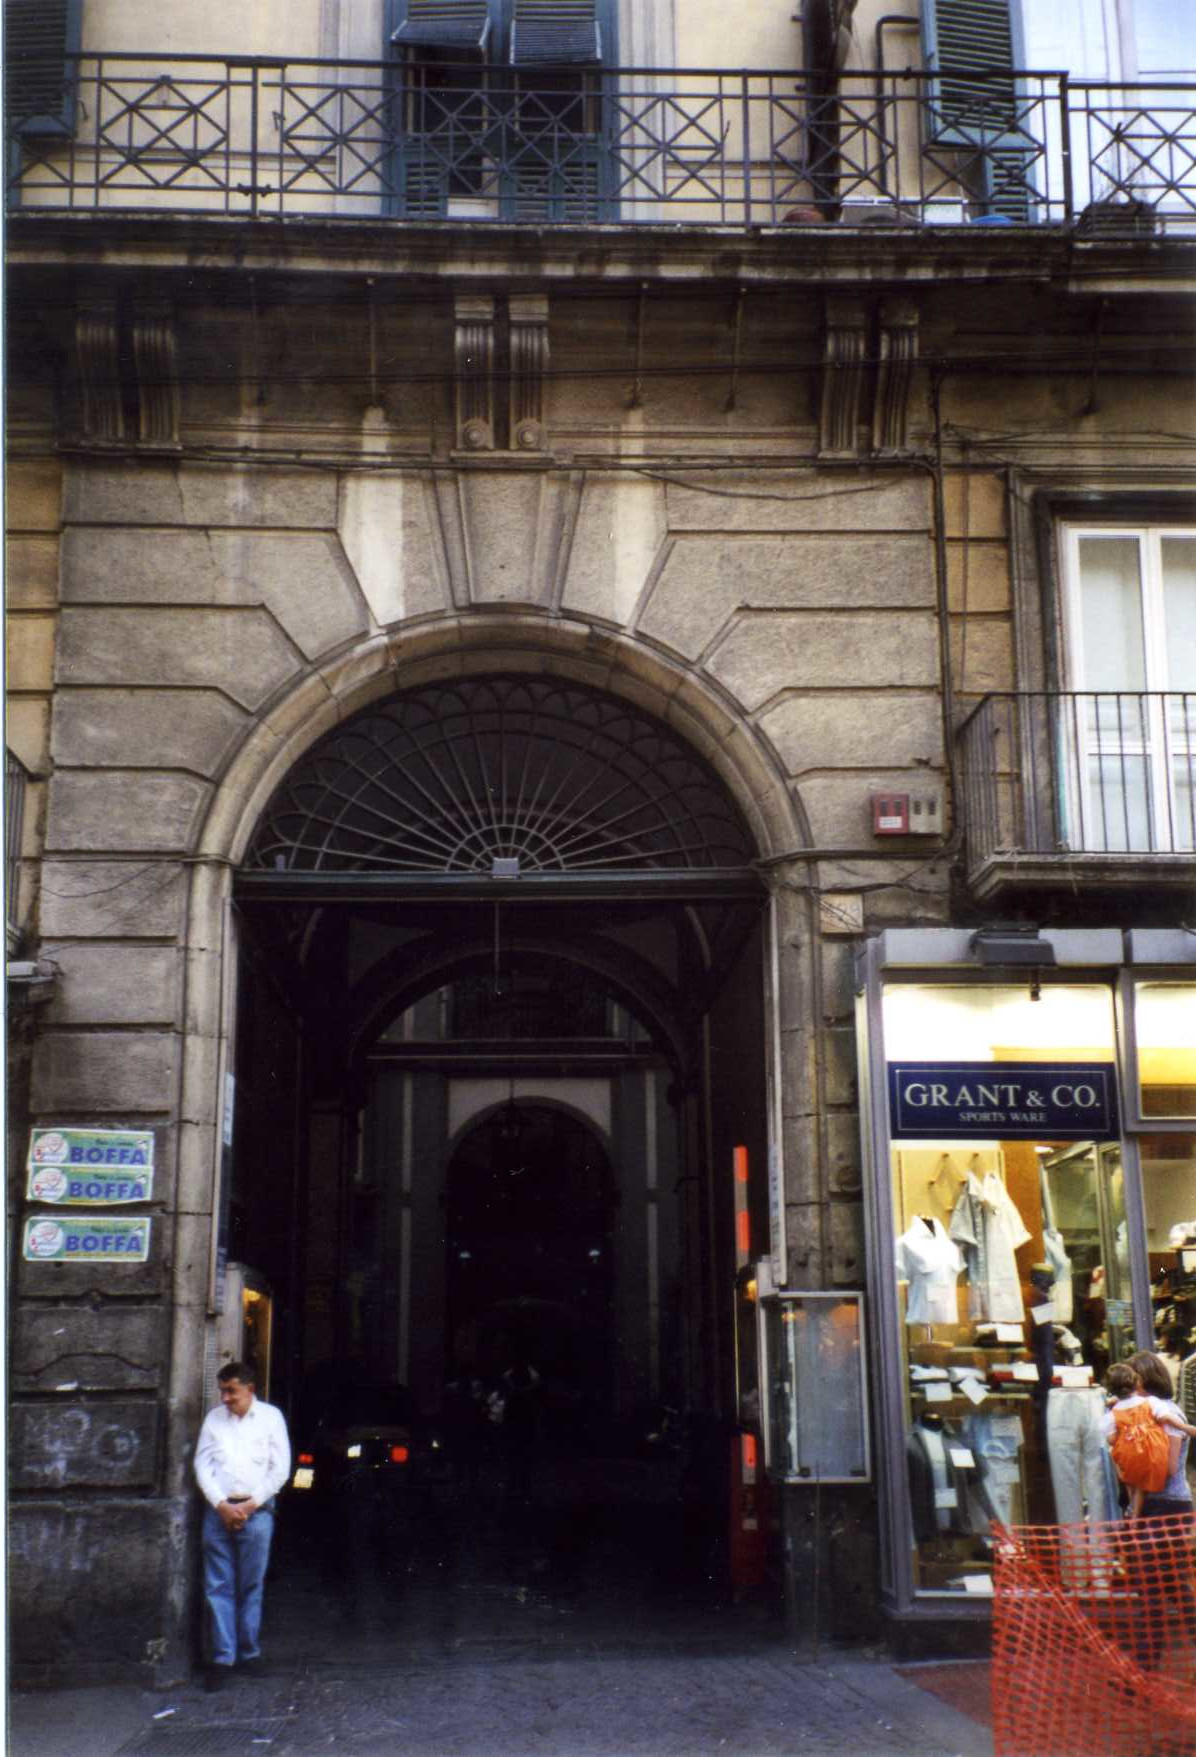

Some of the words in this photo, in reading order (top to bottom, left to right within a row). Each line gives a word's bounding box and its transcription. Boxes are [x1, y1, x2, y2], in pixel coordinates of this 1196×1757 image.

[904, 1083, 1021, 1107] GRANT
[1026, 1090, 1047, 1107] &
[1051, 1085, 1101, 1108] CO.
[959, 1111, 1005, 1122] SPORTS
[1010, 1112, 1047, 1122] WARE
[70, 1147, 145, 1164] BOFFA
[70, 1182, 144, 1198] BOFFA
[66, 1235, 141, 1252] BOFFA
